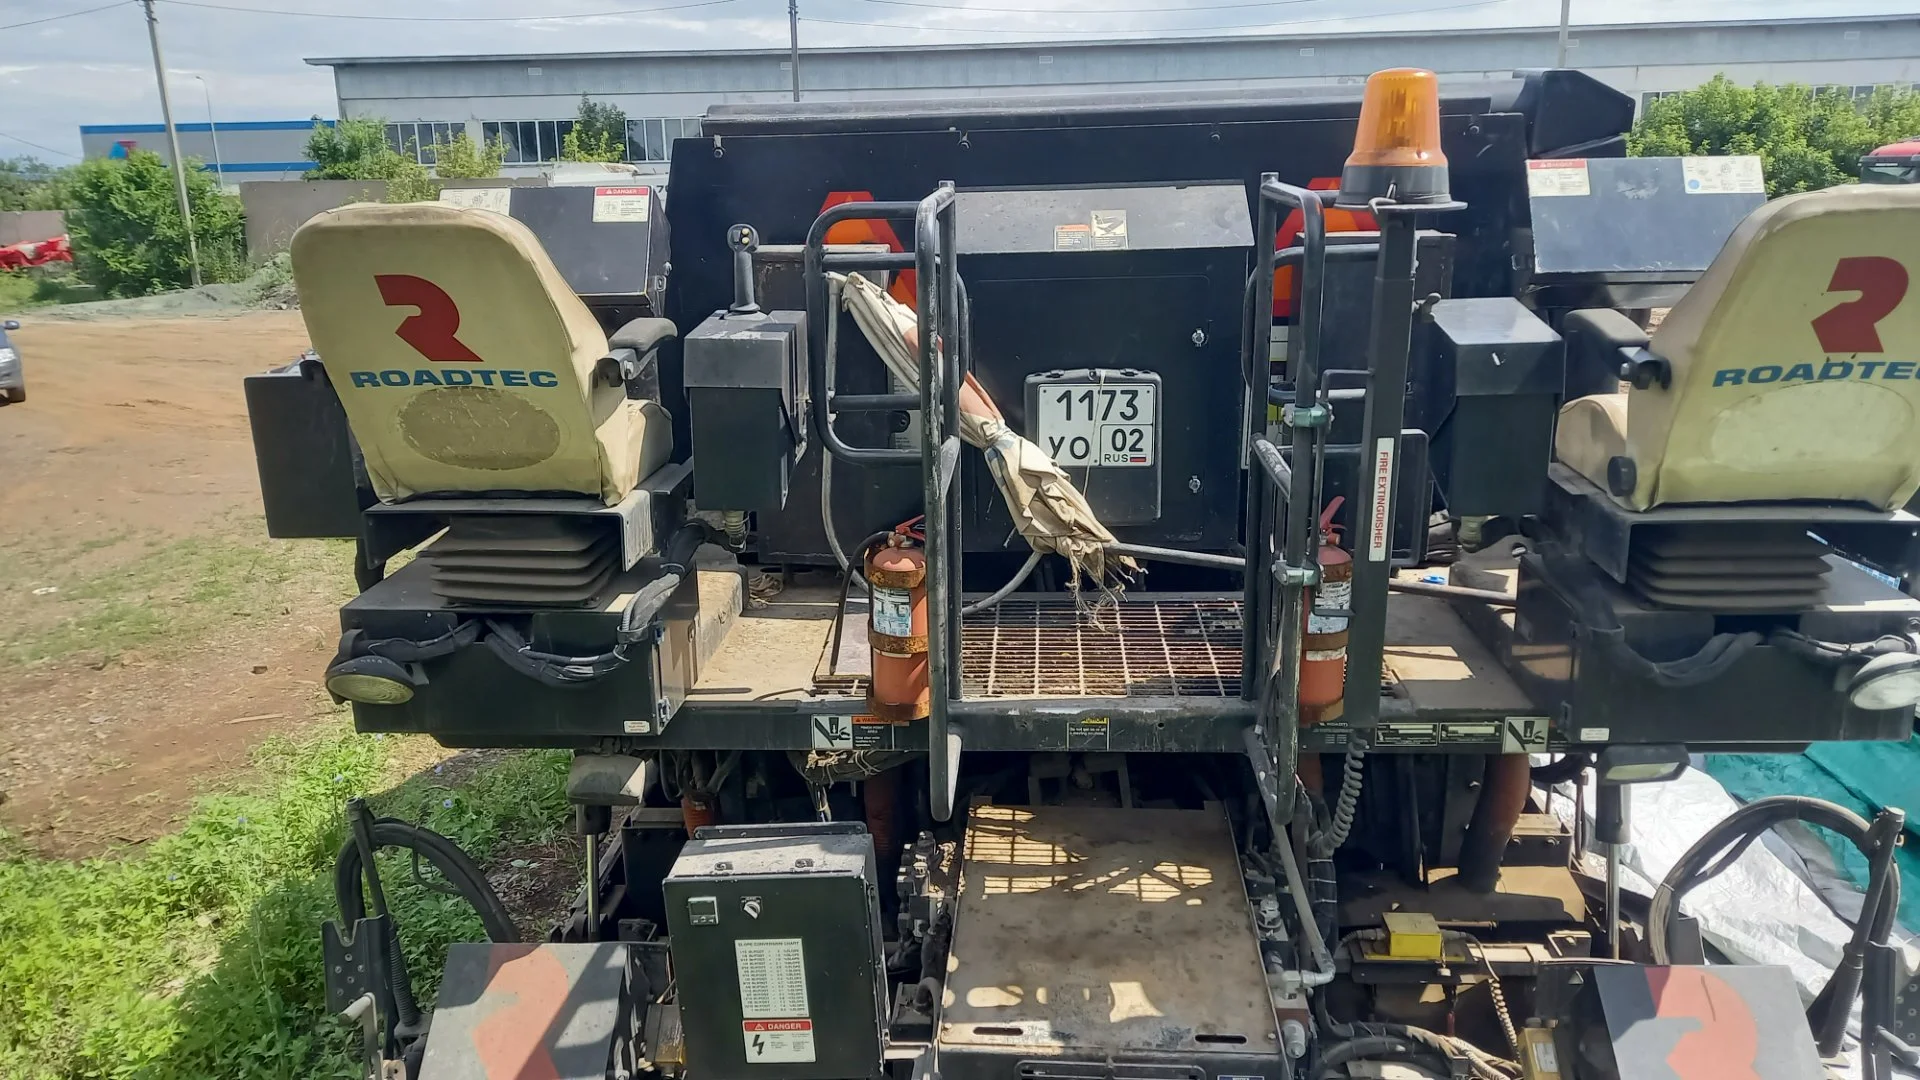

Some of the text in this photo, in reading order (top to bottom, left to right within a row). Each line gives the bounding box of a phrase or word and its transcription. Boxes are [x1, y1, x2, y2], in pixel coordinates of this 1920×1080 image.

[350, 369, 559, 388] ROADTEC
[1712, 361, 1920, 387] ROADTE
[1056, 390, 1139, 421] 1173
[1111, 428, 1144, 452] 02
[1104, 454, 1129, 462] RUS
[1374, 451, 1389, 549] FIRE EXTINGUISHER
